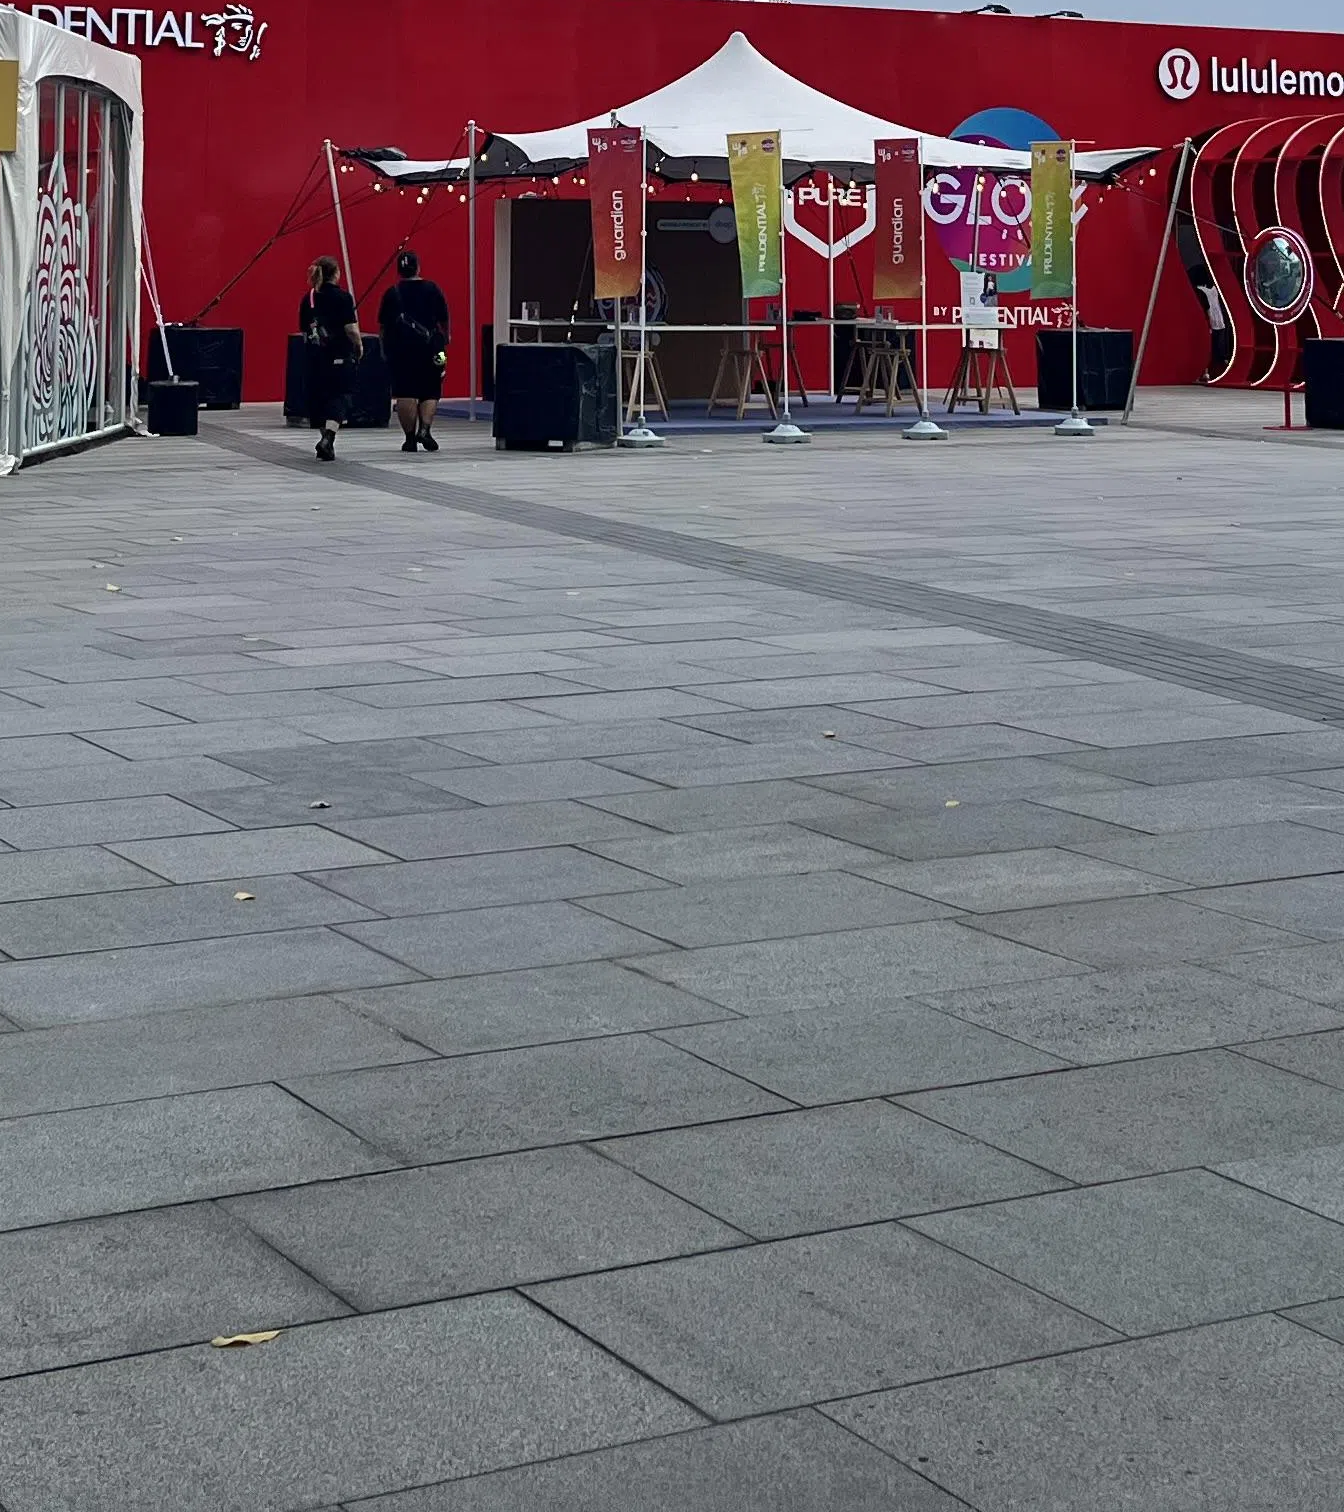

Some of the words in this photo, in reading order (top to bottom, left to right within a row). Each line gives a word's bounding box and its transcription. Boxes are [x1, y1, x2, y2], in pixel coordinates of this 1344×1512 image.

[610, 190, 627, 261] guardian
[798, 187, 862, 207] PURE
[756, 200, 767, 272] PRUDENTIAL
[891, 197, 905, 265] guardian
[1043, 208, 1054, 275] PRUDENTIAL
[933, 306, 947, 317] BY
